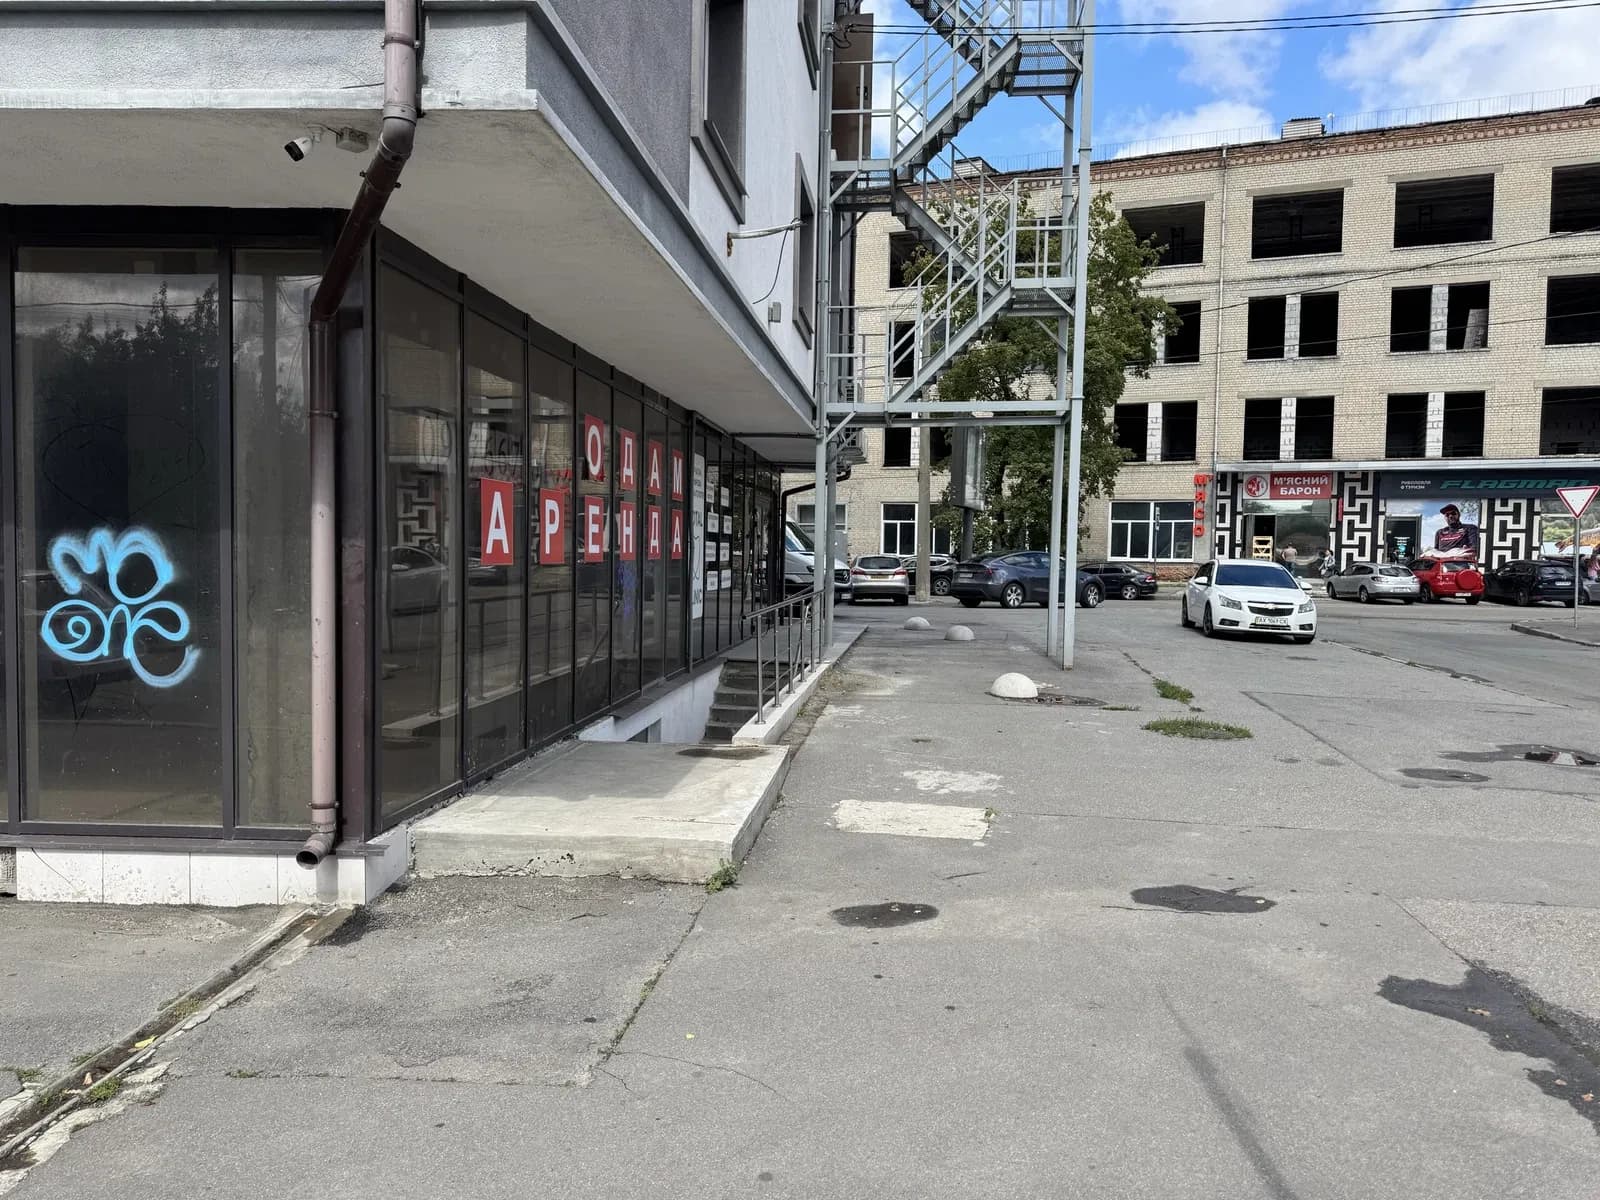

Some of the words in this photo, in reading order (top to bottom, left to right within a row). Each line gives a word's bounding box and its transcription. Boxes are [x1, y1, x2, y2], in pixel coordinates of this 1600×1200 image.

[1273, 475, 1329, 485] М'ЯСНИЙ
[1279, 487, 1321, 496] БАРОН
[485, 490, 683, 556] АРЕНДА
